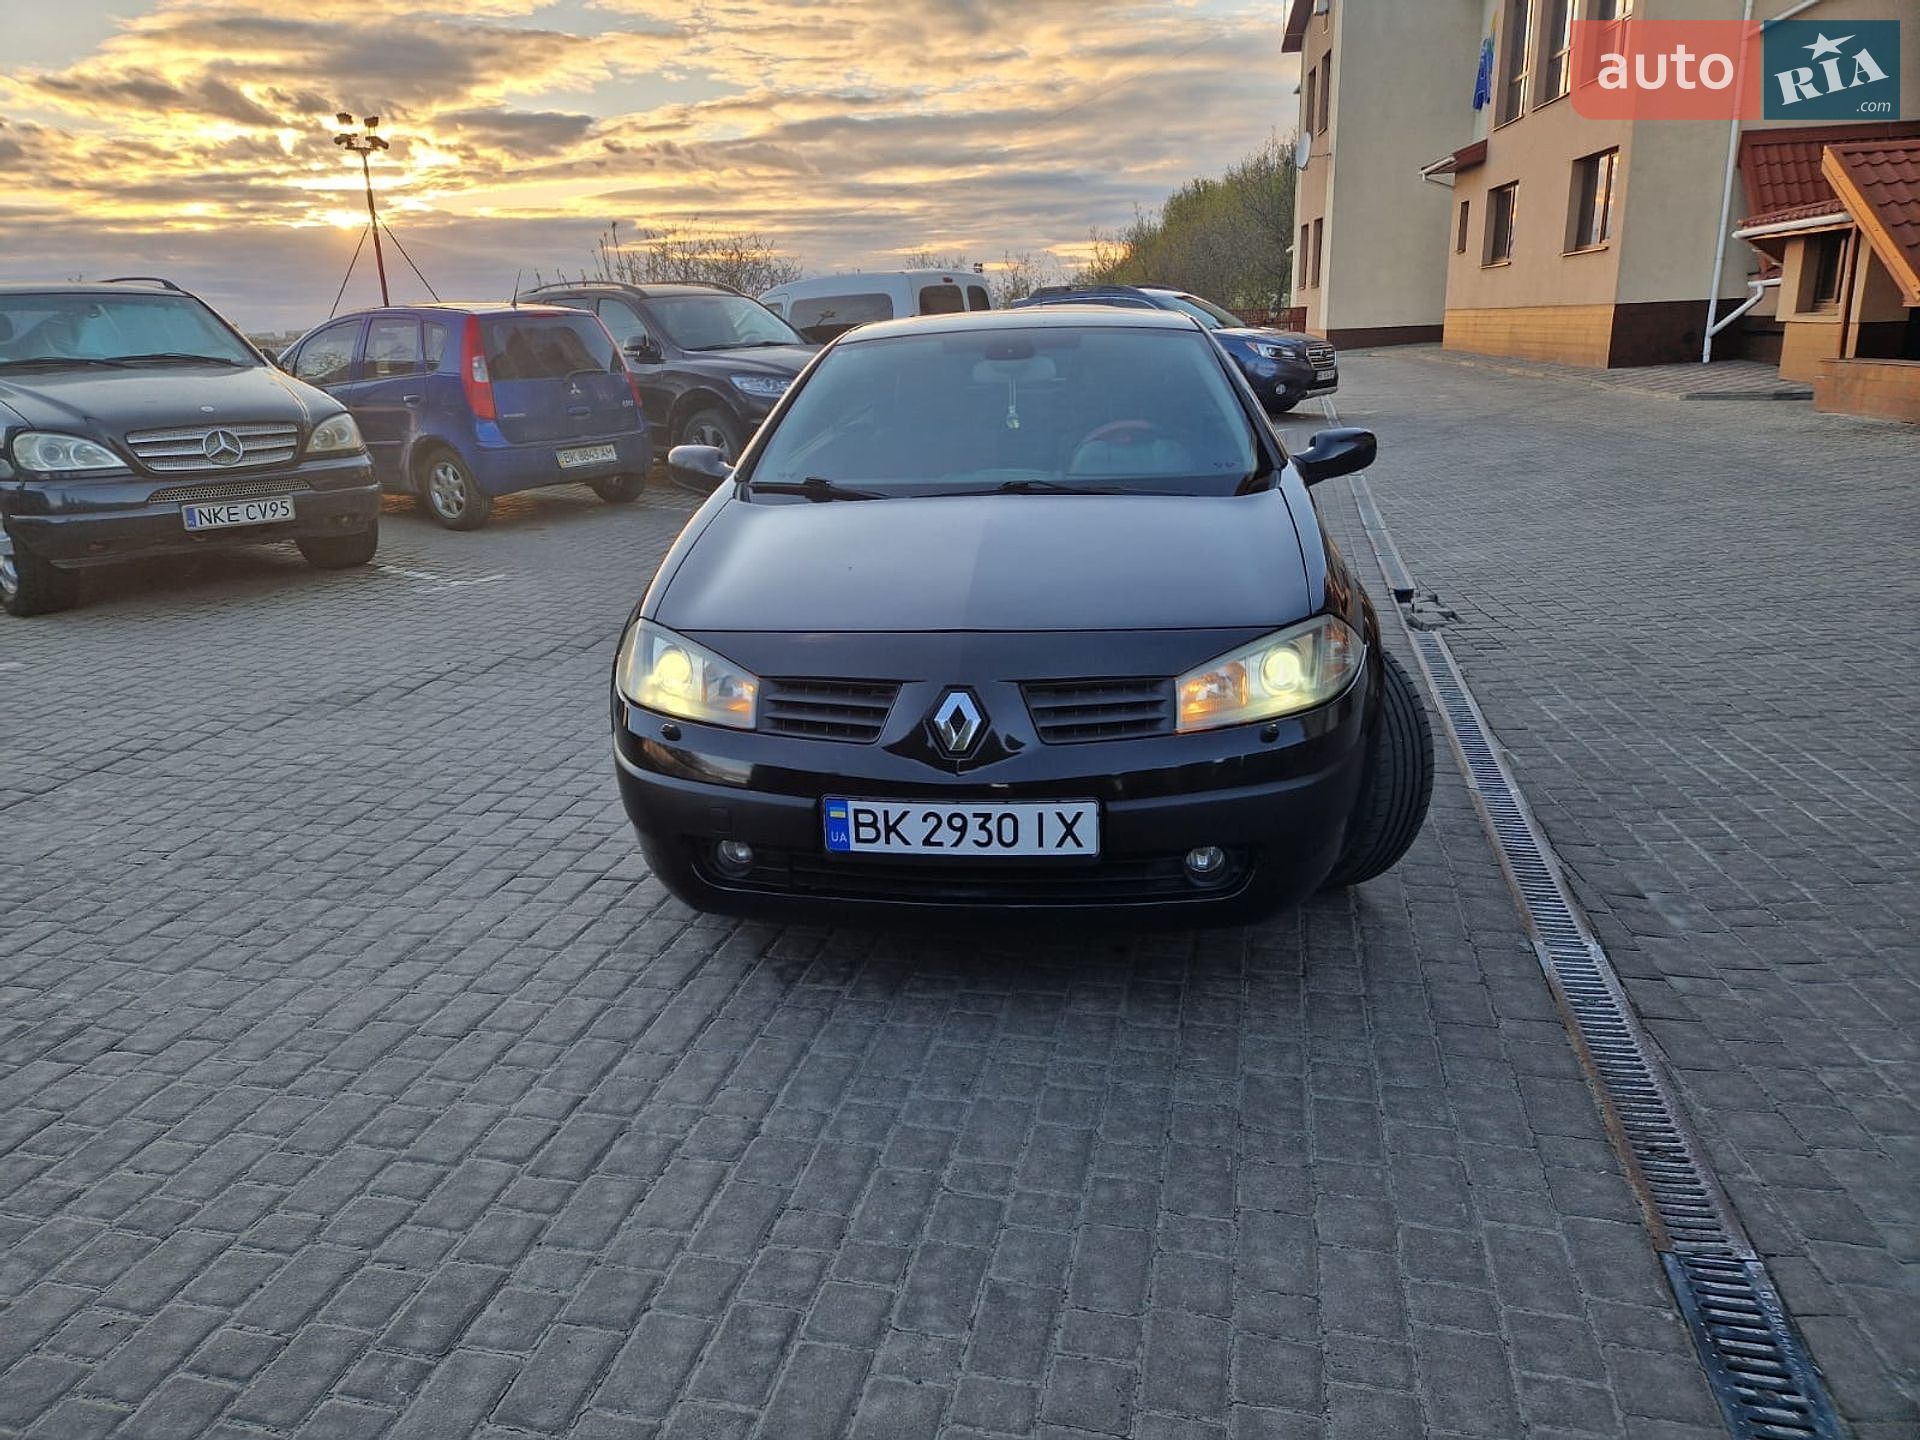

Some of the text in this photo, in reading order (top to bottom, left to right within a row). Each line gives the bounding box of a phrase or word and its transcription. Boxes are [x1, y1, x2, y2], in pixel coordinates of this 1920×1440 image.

[198, 505, 241, 525] NKE
[246, 500, 290, 521] CV95
[831, 832, 848, 843] UA
[852, 808, 1084, 848] BK 2930 IX
